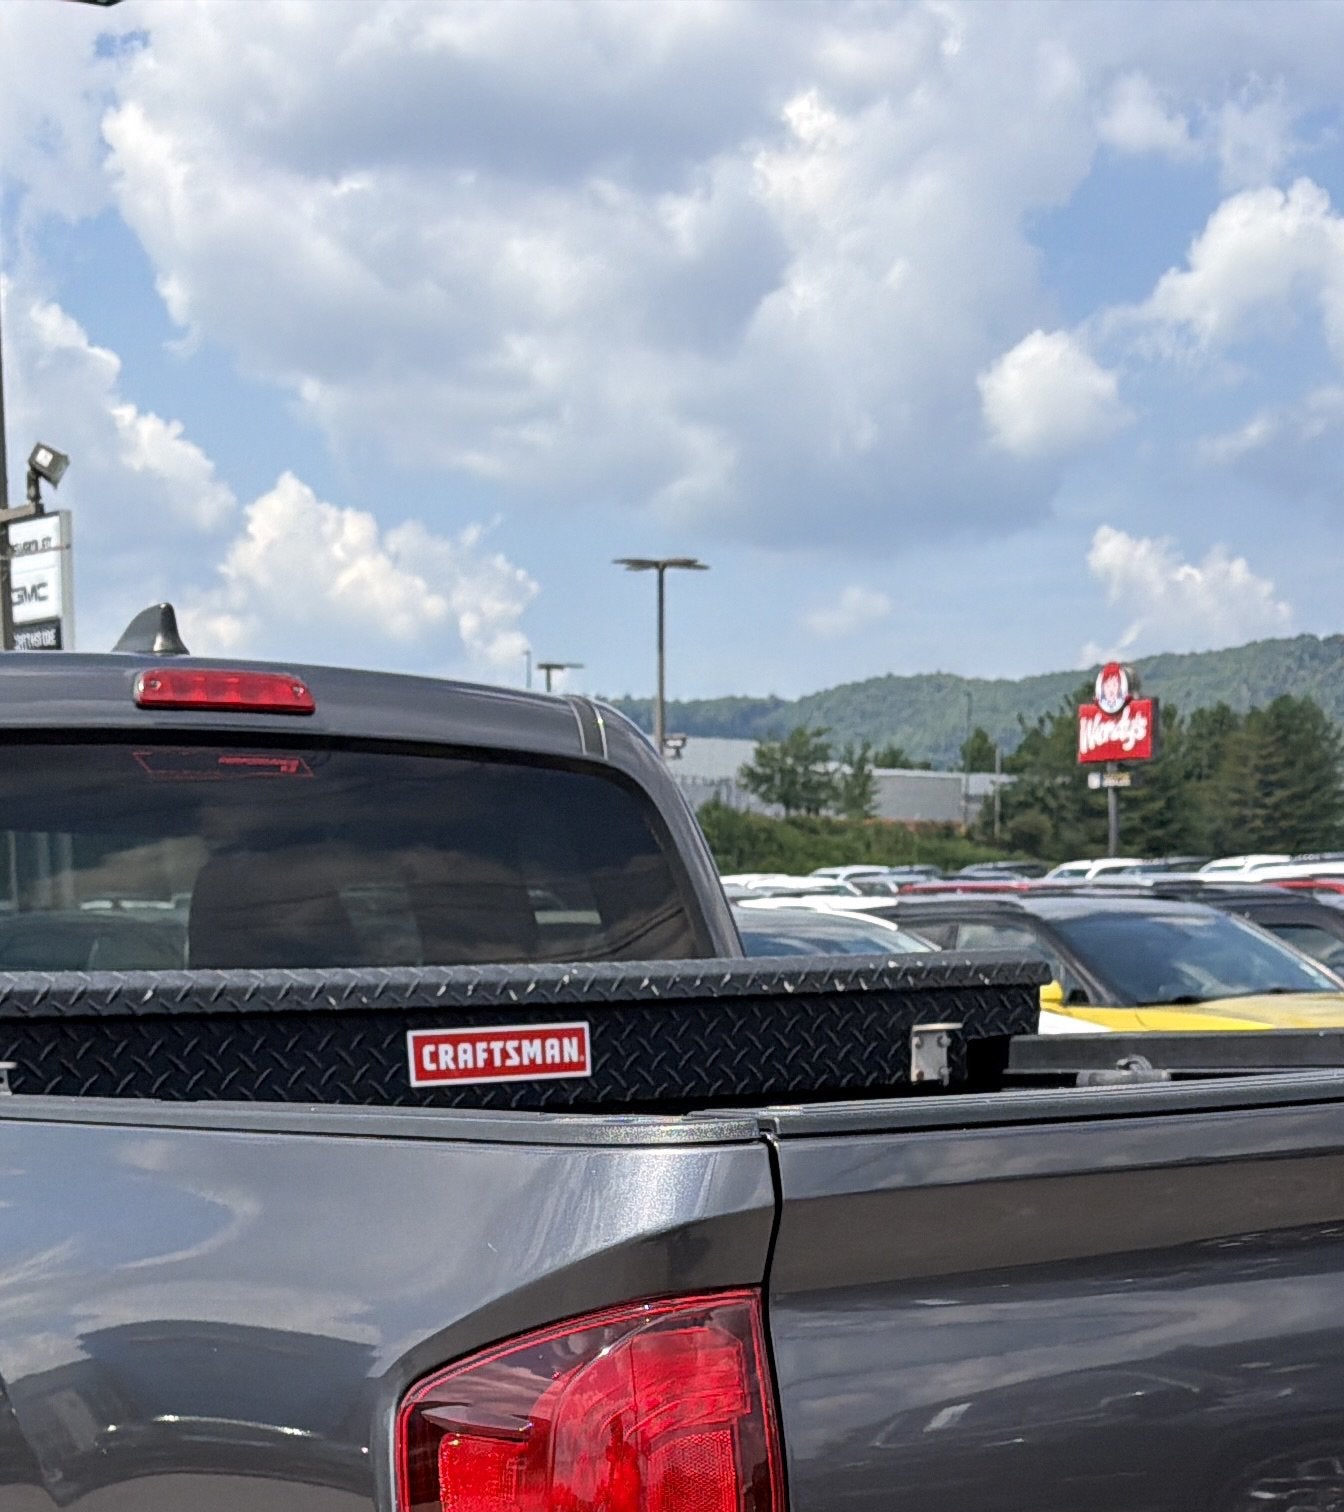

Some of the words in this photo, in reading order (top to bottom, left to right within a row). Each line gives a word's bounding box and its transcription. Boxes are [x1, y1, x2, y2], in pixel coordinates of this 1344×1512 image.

[11, 583, 48, 605] GMC
[1079, 704, 1148, 754] Wendy's
[422, 1036, 579, 1072] CRAFTSMAN
